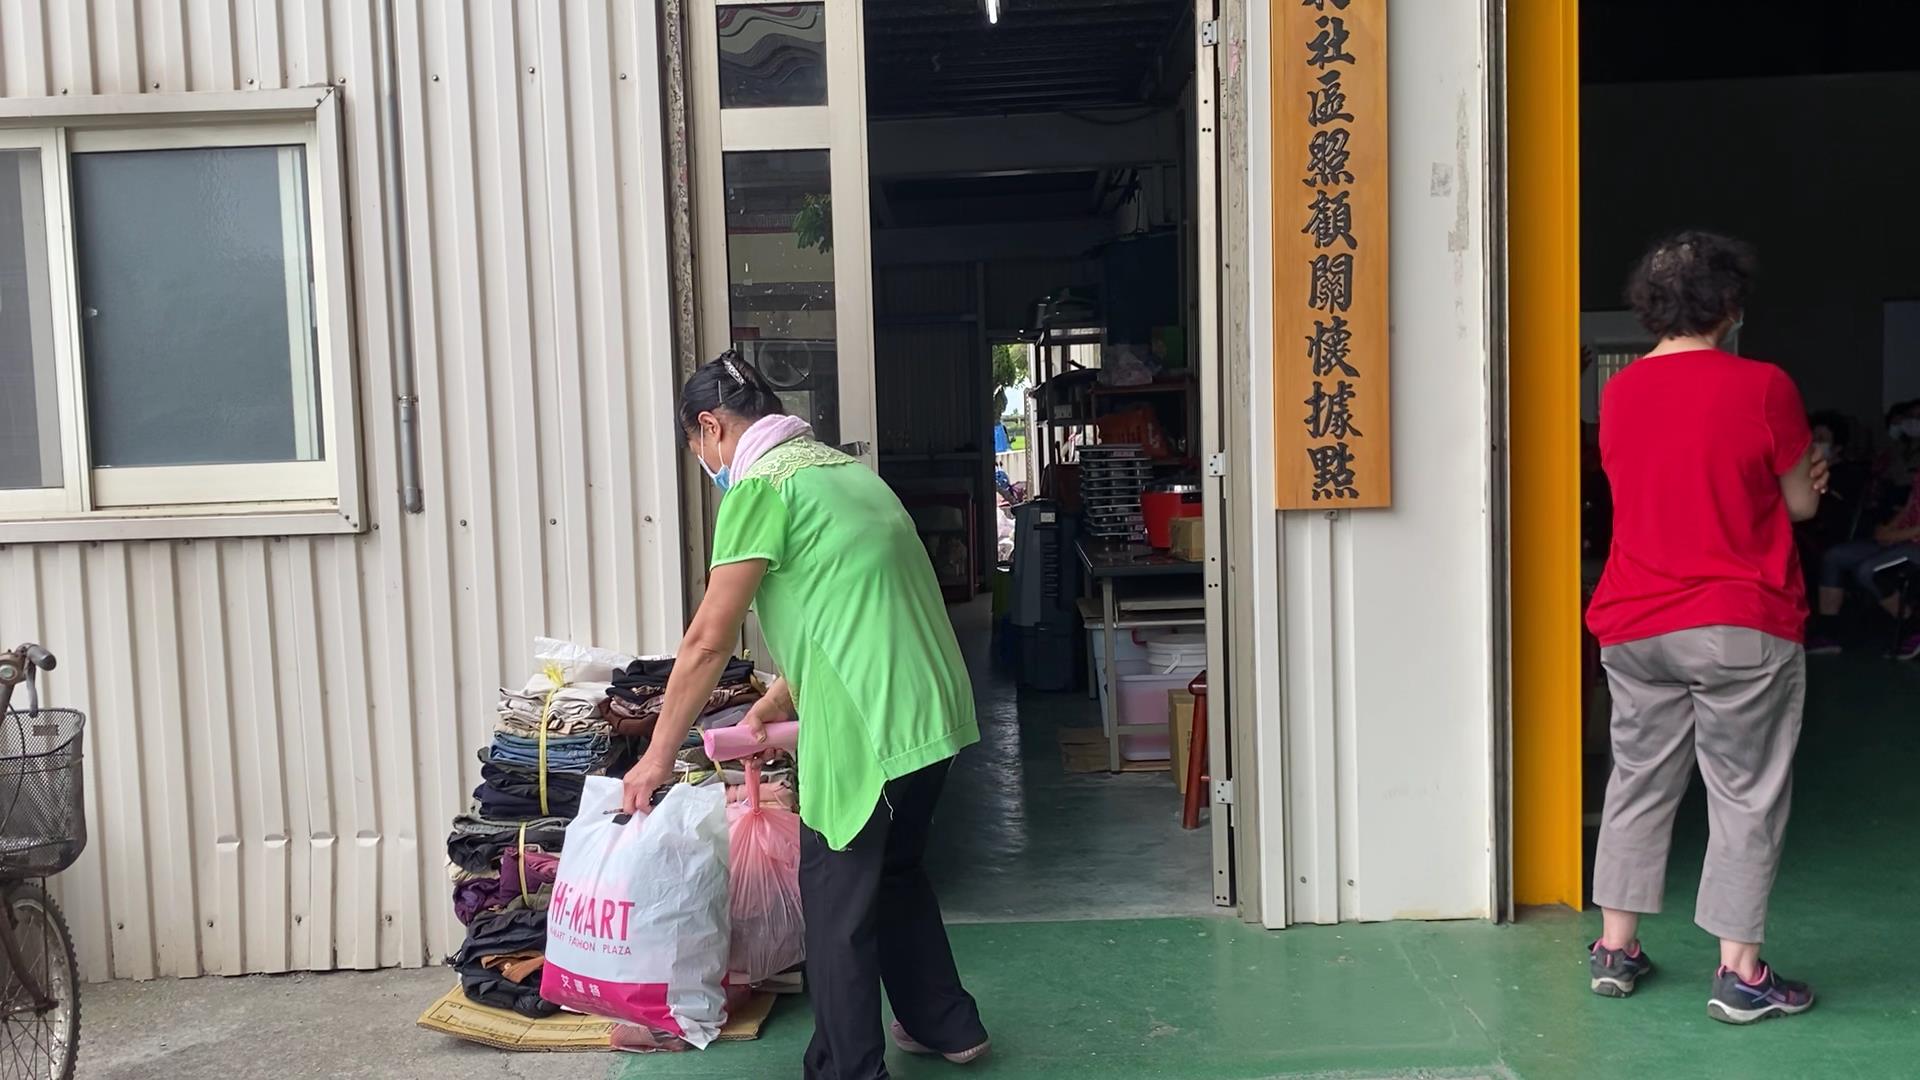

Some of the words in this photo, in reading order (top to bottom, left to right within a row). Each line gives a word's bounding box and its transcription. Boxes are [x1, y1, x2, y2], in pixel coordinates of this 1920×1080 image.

[1301, 0, 1363, 501] 社區照顧關懷據點
[551, 880, 635, 941] Hi-MART
[602, 943, 632, 956] PLAZA
